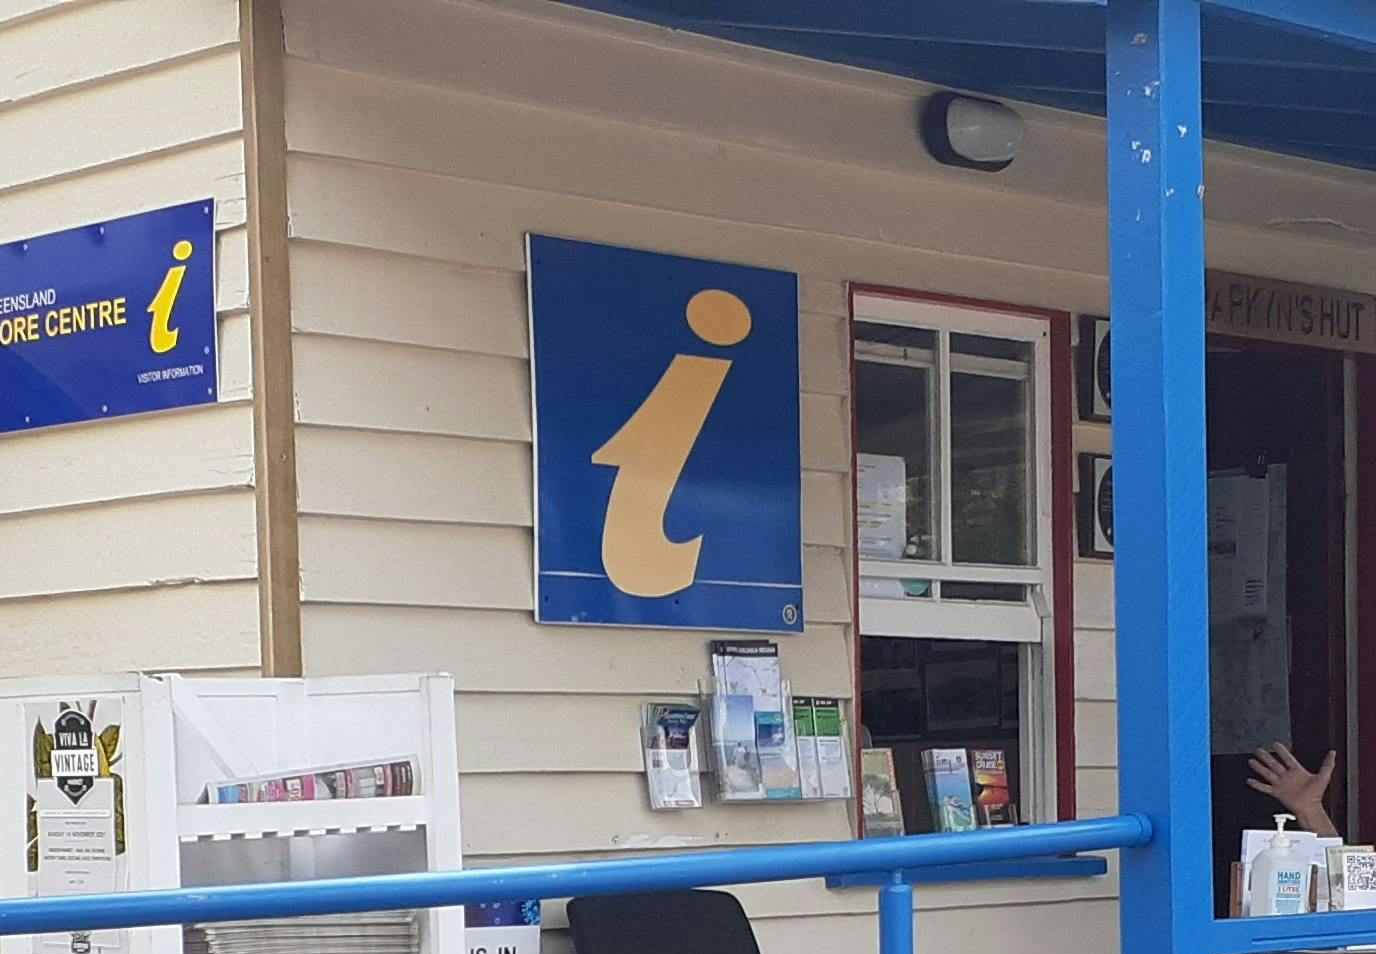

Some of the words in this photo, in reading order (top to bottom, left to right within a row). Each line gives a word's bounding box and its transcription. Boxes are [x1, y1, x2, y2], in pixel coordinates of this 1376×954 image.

[45, 297, 127, 337] CENTRE
[1320, 296, 1365, 341] HUT
[137, 370, 161, 384] VISITOR
[161, 364, 204, 381] INFORMATION
[58, 732, 78, 747] VIVA
[79, 732, 89, 746] LA
[54, 754, 95, 773] VINTAGE
[1278, 871, 1301, 880] HAND
